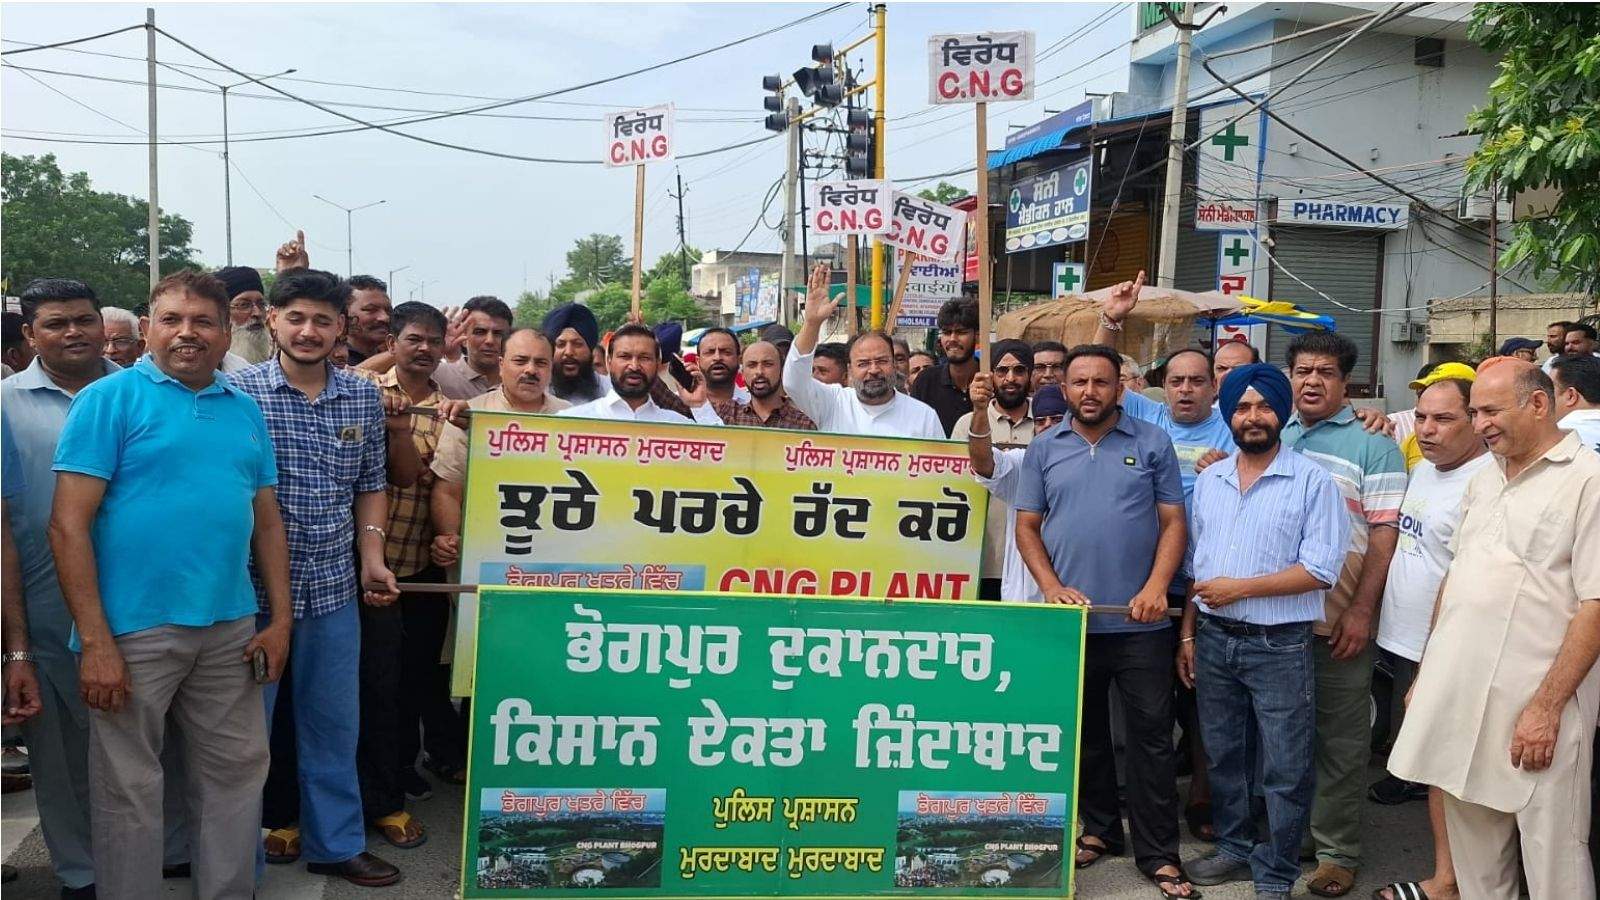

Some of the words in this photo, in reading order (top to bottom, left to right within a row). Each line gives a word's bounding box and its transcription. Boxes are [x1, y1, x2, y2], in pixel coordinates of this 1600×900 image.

[942, 35, 1018, 66] ਵਿਰੋਧ
[939, 69, 1024, 99] C.N.G
[613, 111, 664, 138] ਵਿਰੋਧ
[611, 135, 667, 163] C.N.G
[819, 183, 878, 206] ਵਿਰੋਧ
[817, 208, 882, 231] C.N.G
[894, 196, 951, 230] ਵਿਰੋਧ
[1293, 202, 1400, 223] PHARMACY
[885, 220, 949, 255] C.N.G
[488, 423, 549, 457] ਪੁਲਿਸ
[557, 433, 630, 461] ਪ੍ਰਸ਼ਾਸਨ
[638, 438, 725, 463] ਮੁਰਦਾਬਾਦ
[786, 441, 835, 471] ਪੁਲਿਸ
[842, 450, 902, 475] ਪ੍ਰਸ਼ਾਸਨ
[499, 470, 600, 555] ਝੂਠੇ
[632, 477, 764, 535] ਪਰਚੇ
[793, 482, 872, 539] ਰੱਦ
[898, 486, 972, 542] ਕਰੋ
[719, 568, 818, 595] CNG
[830, 570, 970, 600] PLANT
[565, 604, 742, 689] ਭੋਗਪੁਰ
[768, 626, 1011, 692] ਦੁਕਾਨਦਾਰ,
[490, 698, 660, 766] ਕਿਸਾਨ
[687, 699, 827, 767] ਏਕਤਾ
[713, 788, 775, 829] ਪੁਲਿਸ
[783, 797, 859, 830] ਪ੍ਰਸ਼ਾਸਨ
[680, 847, 780, 879] ਮੁਰਦਾਬਾਦ
[788, 847, 885, 879] ਮੁਰਦਾਬਾਦ
